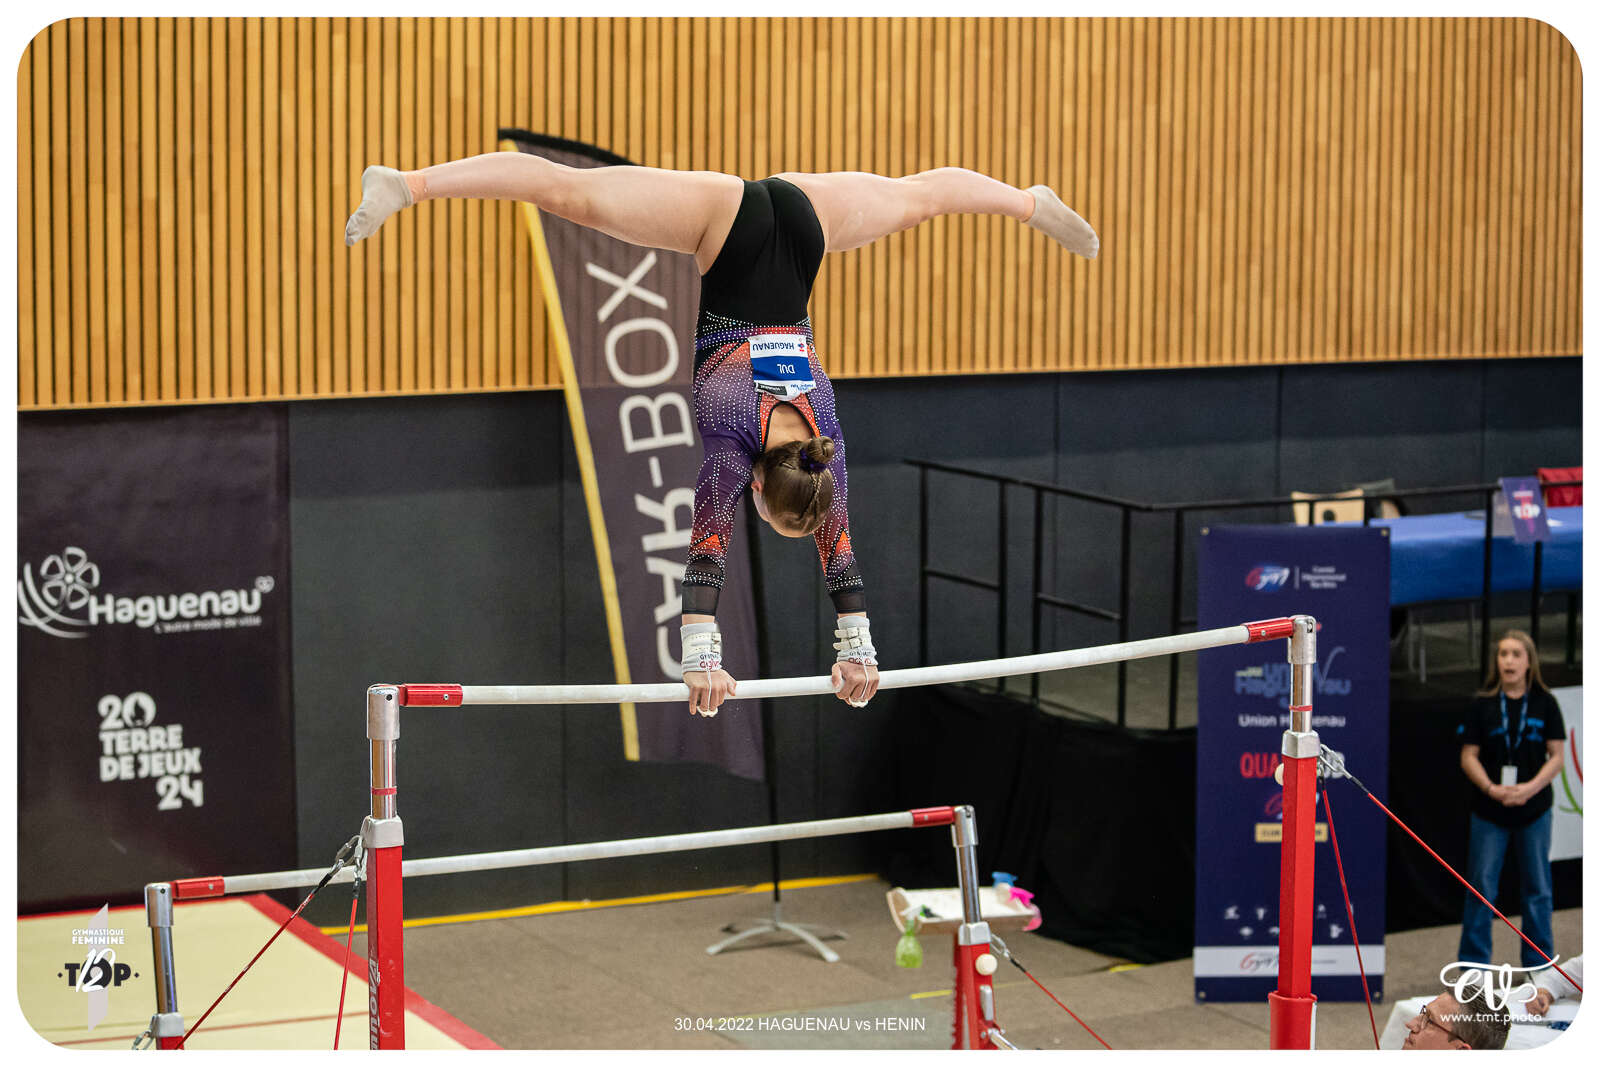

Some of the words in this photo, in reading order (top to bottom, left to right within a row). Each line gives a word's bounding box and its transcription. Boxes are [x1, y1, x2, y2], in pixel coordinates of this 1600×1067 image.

[752, 342, 795, 351] HAGUENAU
[777, 363, 795, 374] DUL
[89, 588, 261, 628] Haguenau
[98, 724, 183, 755] TERRE
[99, 755, 135, 782] DE
[137, 748, 202, 779] JEUX
[156, 776, 203, 810] 24
